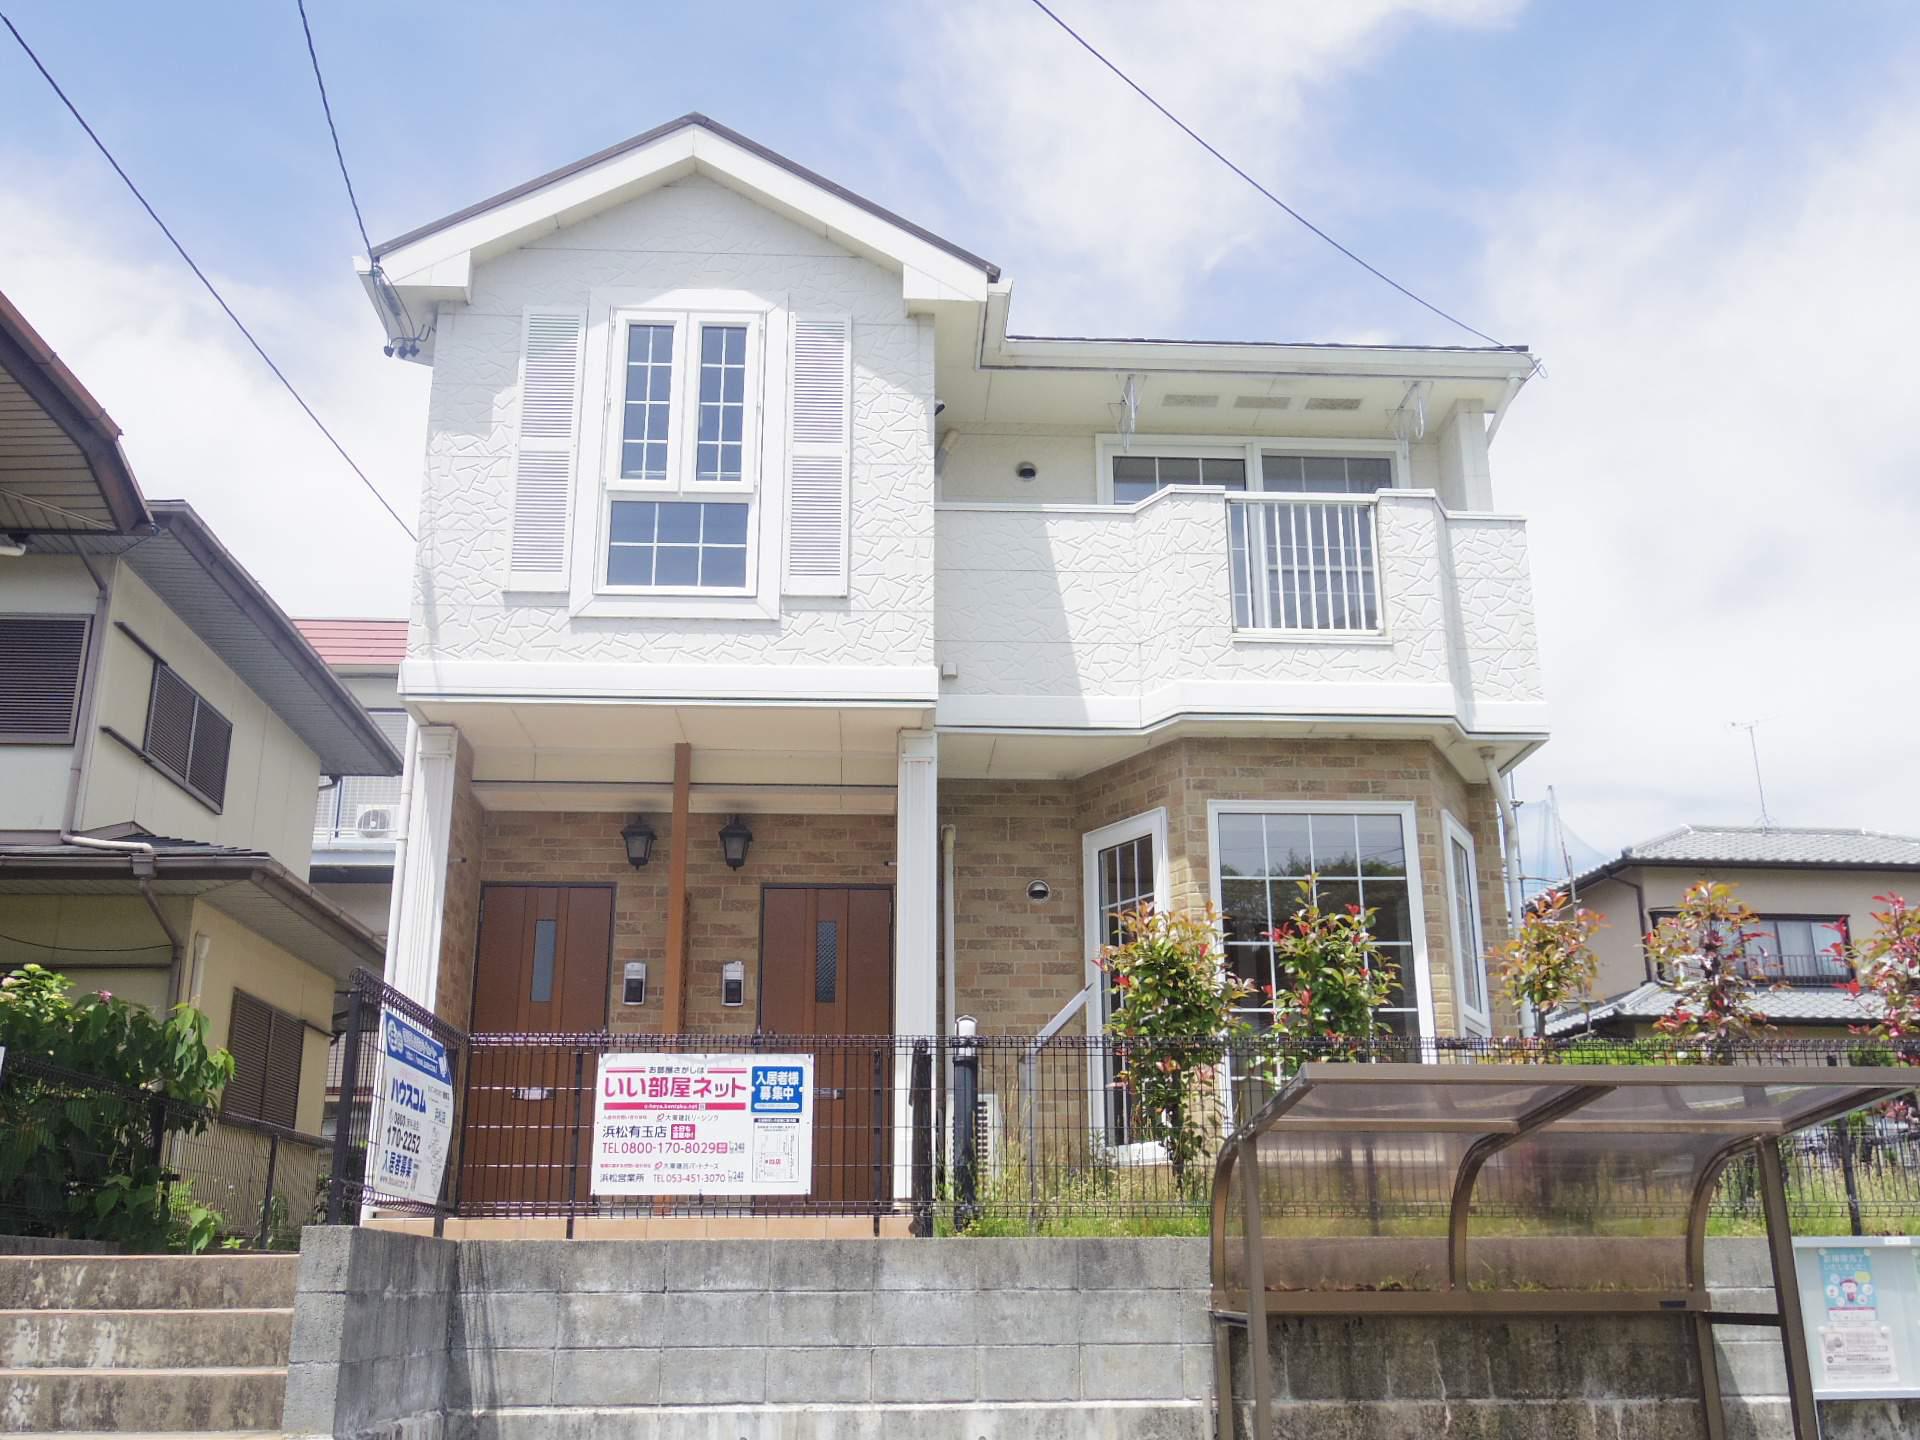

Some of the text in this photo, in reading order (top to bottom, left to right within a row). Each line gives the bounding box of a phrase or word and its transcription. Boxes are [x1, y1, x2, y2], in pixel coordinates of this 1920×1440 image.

[755, 1071, 799, 1085] 入居者様
[391, 1077, 427, 1114] ハウスコム
[604, 1077, 747, 1098] いい部屋ネット
[760, 1086, 794, 1100] 募集中
[387, 1125, 421, 1154] 170-2252
[602, 1125, 667, 1138] 浜松有玉店
